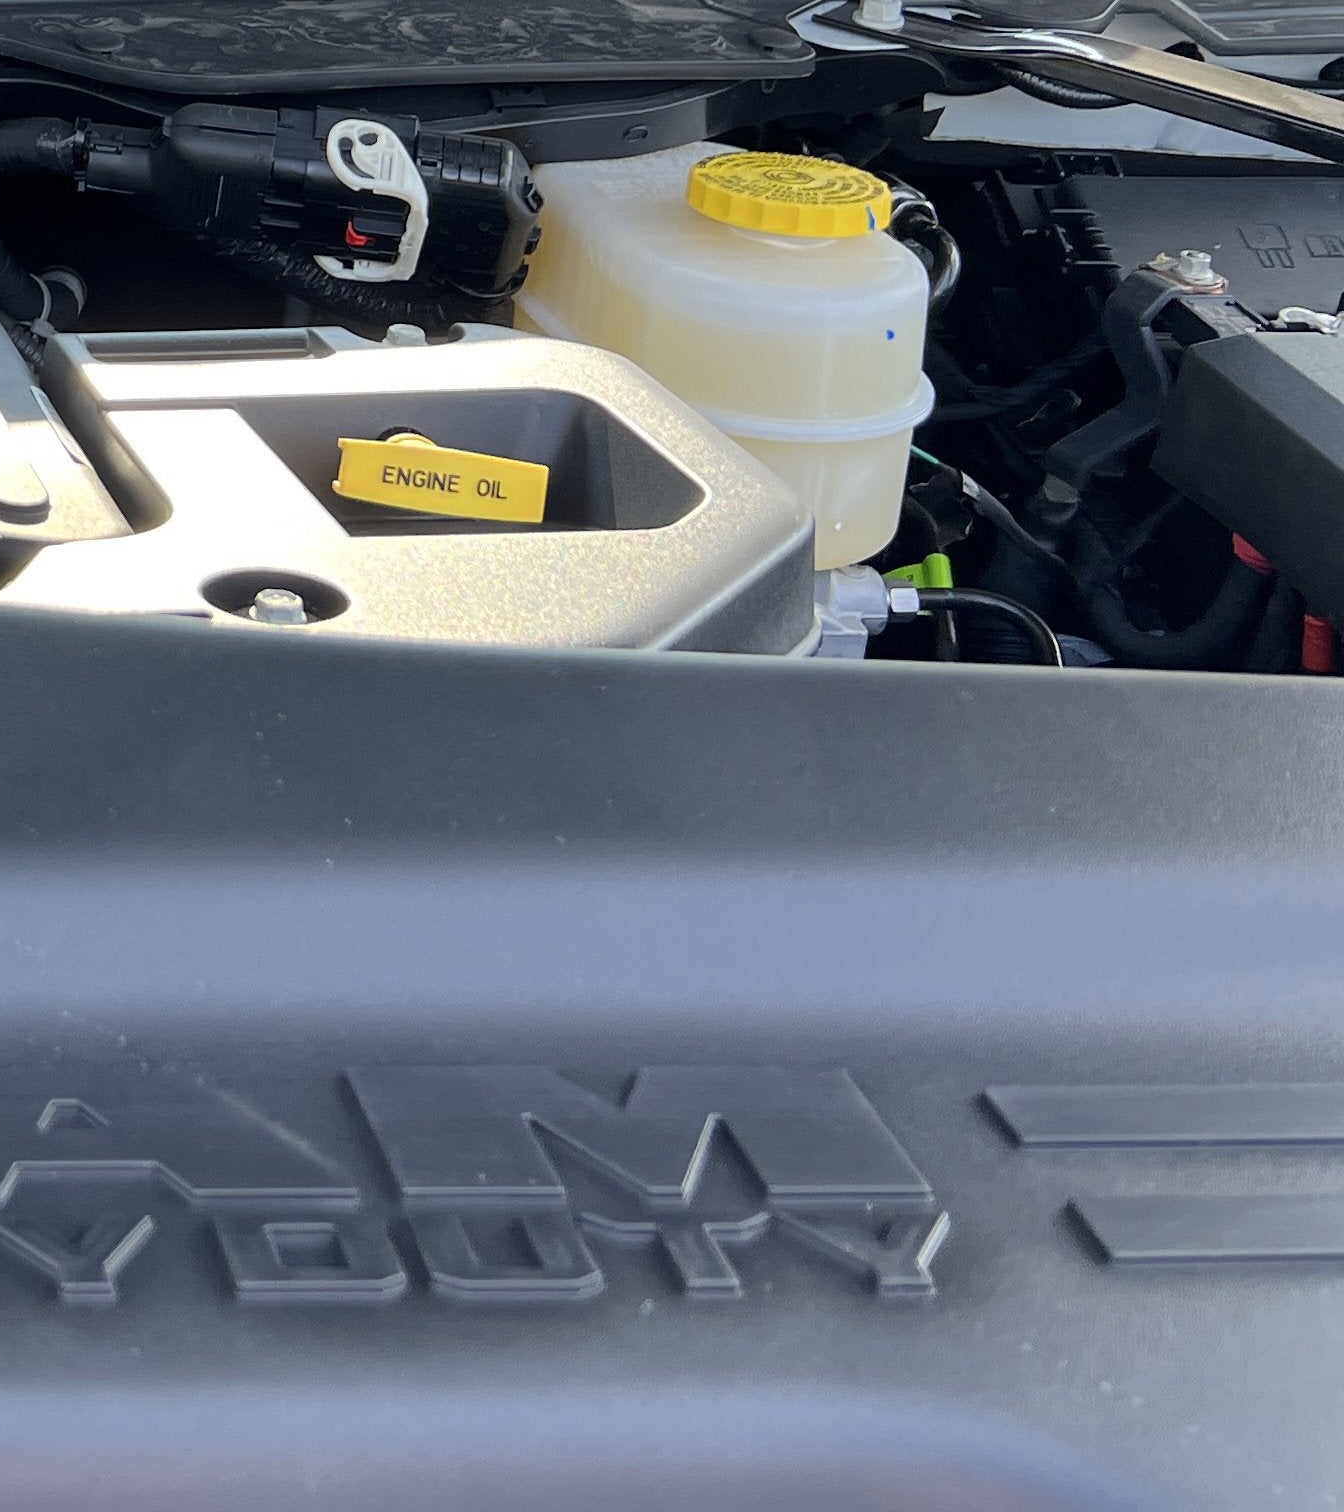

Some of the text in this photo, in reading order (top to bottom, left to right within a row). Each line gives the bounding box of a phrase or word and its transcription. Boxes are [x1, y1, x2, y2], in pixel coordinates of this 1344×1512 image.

[381, 464, 508, 500] ENGINE OIL
[210, 1210, 952, 1300] DUTY
